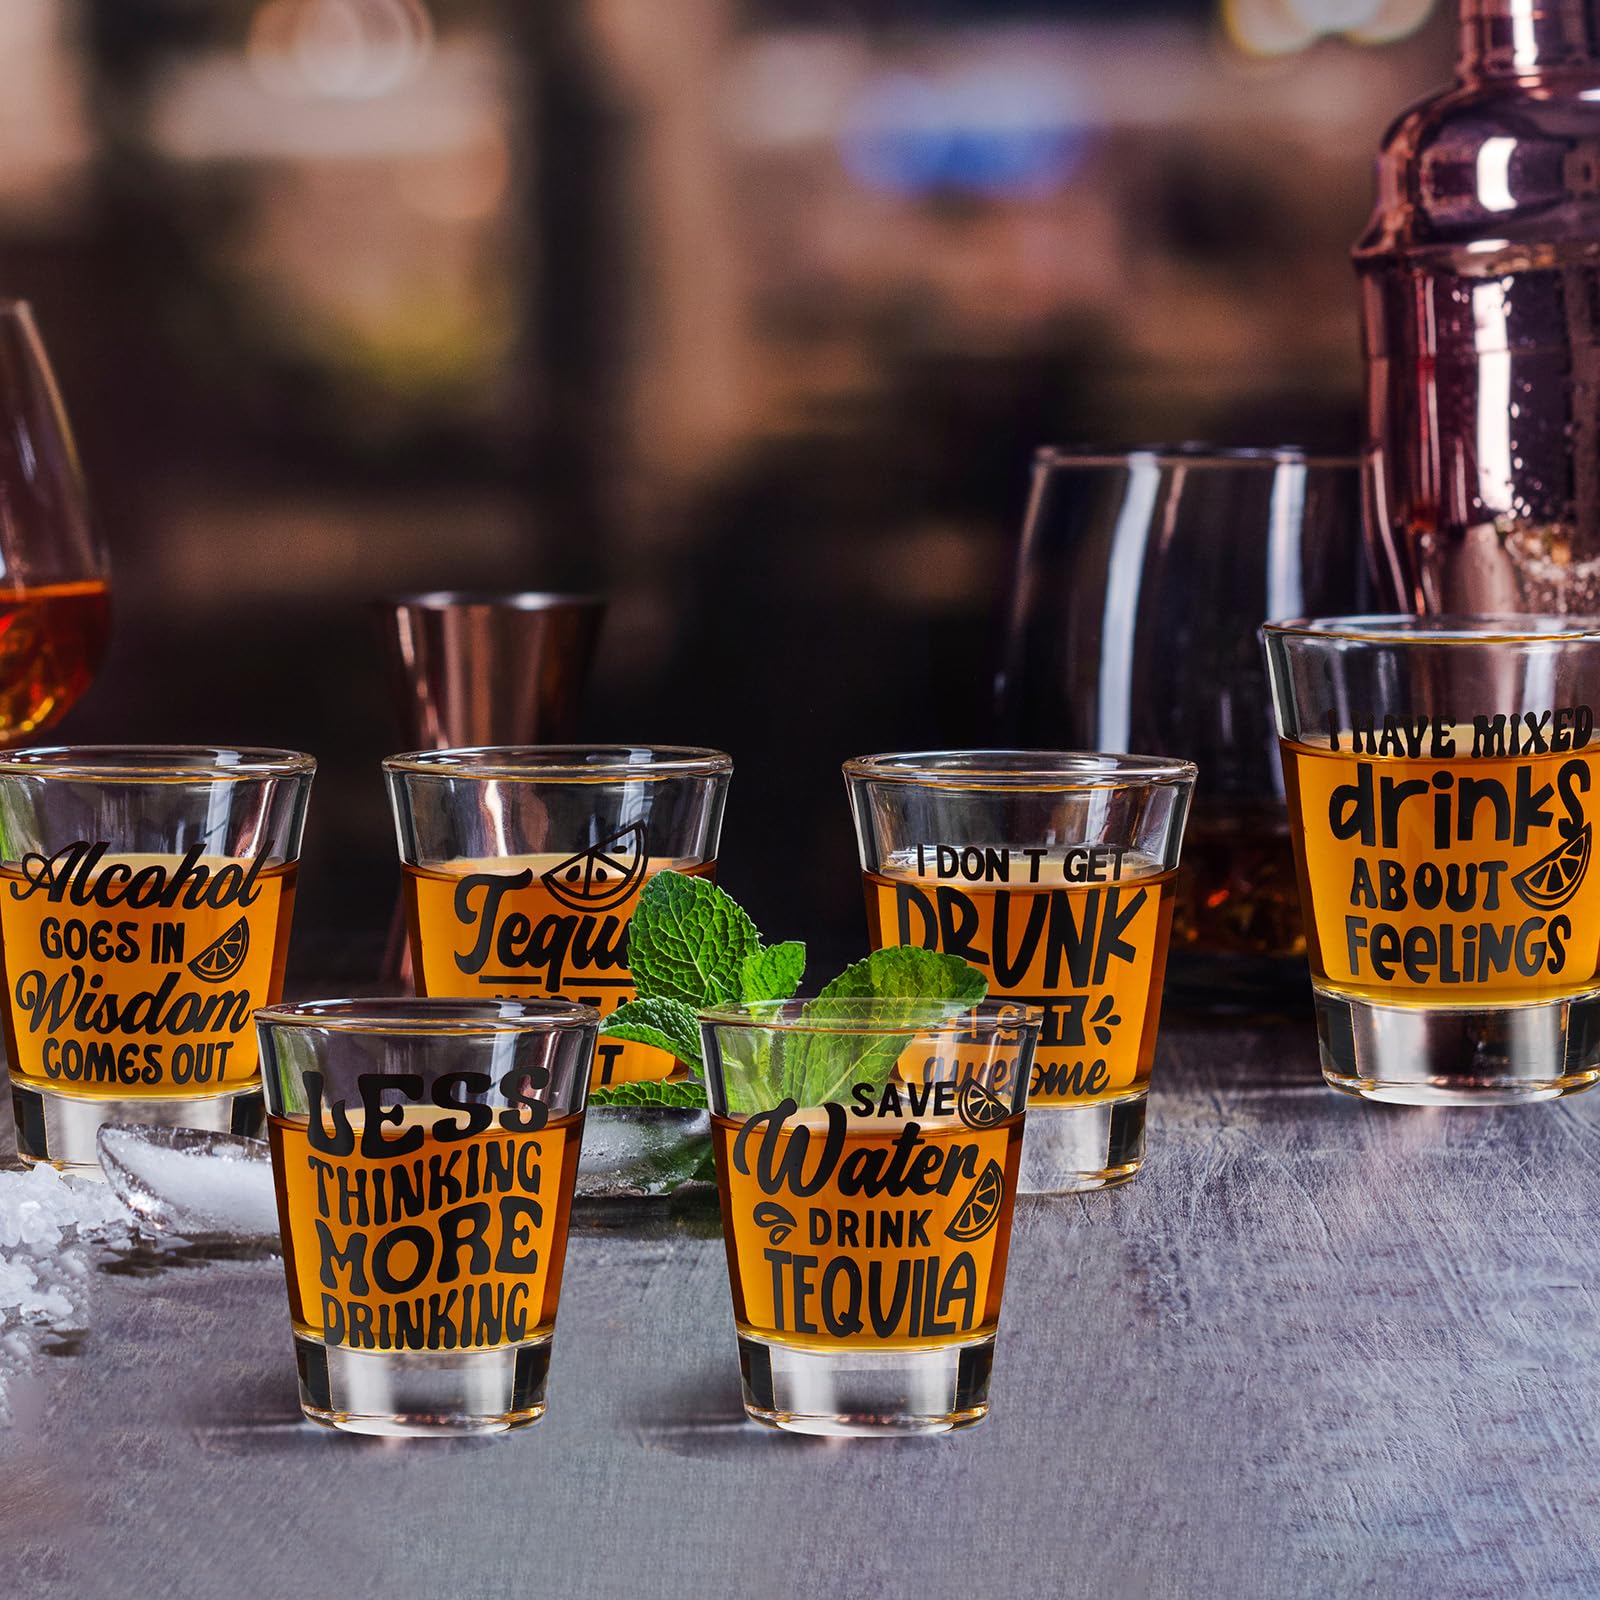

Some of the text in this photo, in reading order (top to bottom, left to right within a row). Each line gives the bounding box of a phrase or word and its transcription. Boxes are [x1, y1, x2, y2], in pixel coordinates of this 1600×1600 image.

[1328, 705, 1593, 758] I HAVE MIXED
[1329, 759, 1591, 849] drinks
[10, 840, 275, 909] Alcohol
[917, 843, 925, 877] I
[1063, 849, 1128, 882] GET
[1350, 857, 1508, 912] ABOUT
[40, 917, 185, 964] GOES IN
[895, 882, 1148, 989] DRUNK
[15, 965, 251, 1035] Wisdom
[997, 1005, 1072, 1041] GET
[42, 1037, 234, 1085] COMES OUT
[302, 1066, 550, 1159] LESS
[851, 1081, 955, 1118] SAVE
[733, 1097, 979, 1198] Water
[308, 1139, 542, 1227] THINKING
[315, 1196, 543, 1297] MORE
[809, 1207, 933, 1248] DRINK
[321, 1282, 529, 1350] DRINKING
[763, 1248, 977, 1338] TEQUILA
